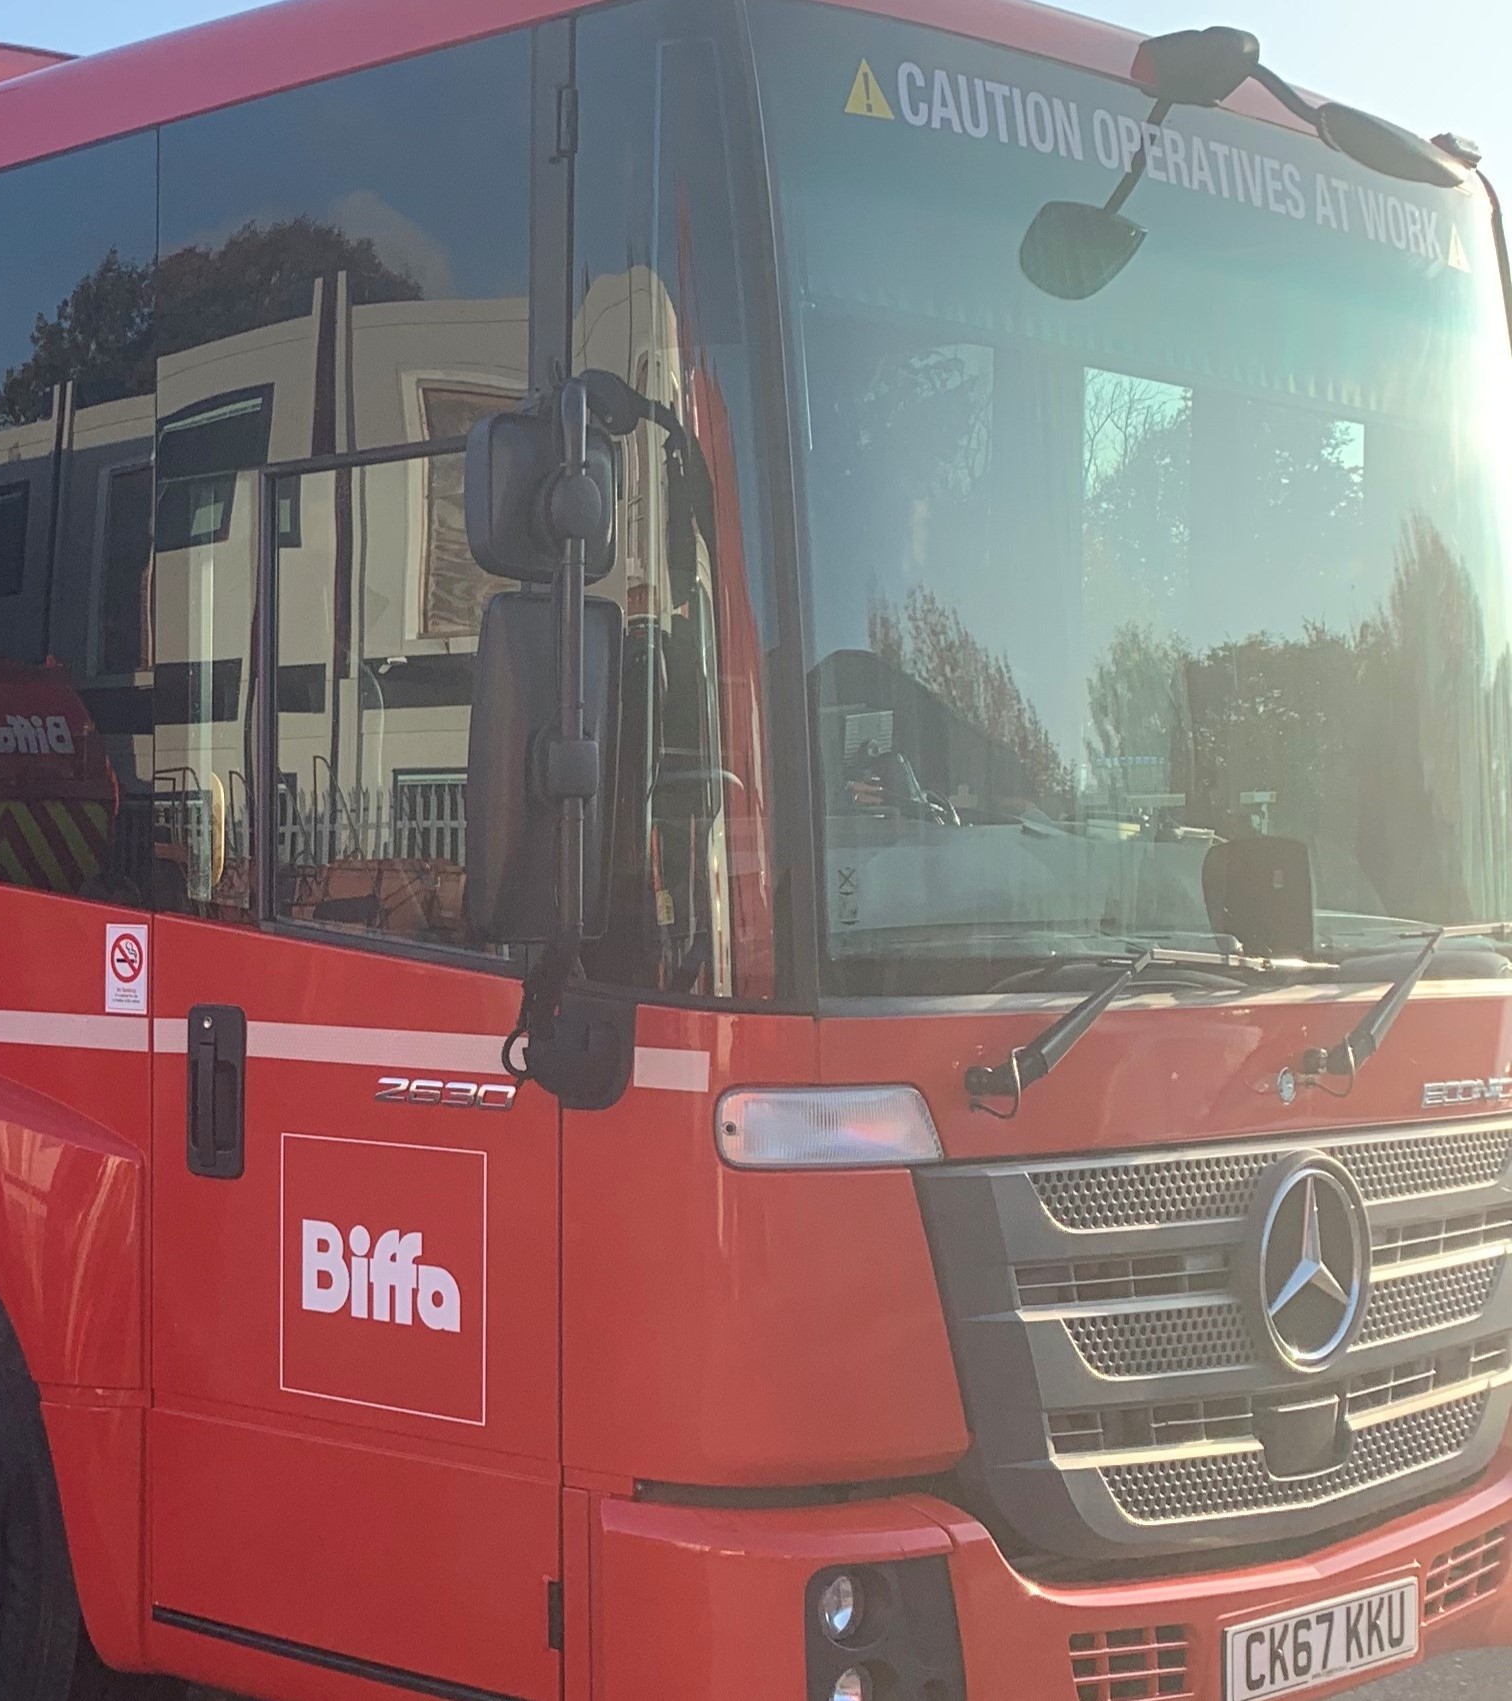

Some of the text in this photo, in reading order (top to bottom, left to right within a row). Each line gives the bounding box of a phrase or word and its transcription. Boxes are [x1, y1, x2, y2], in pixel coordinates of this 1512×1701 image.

[897, 61, 1444, 260] CAUTION OPERATIVES AT WORK
[374, 1077, 517, 1111] 2630
[302, 1218, 461, 1332] Biffa
[1245, 1590, 1405, 1691] CK67 KKU
